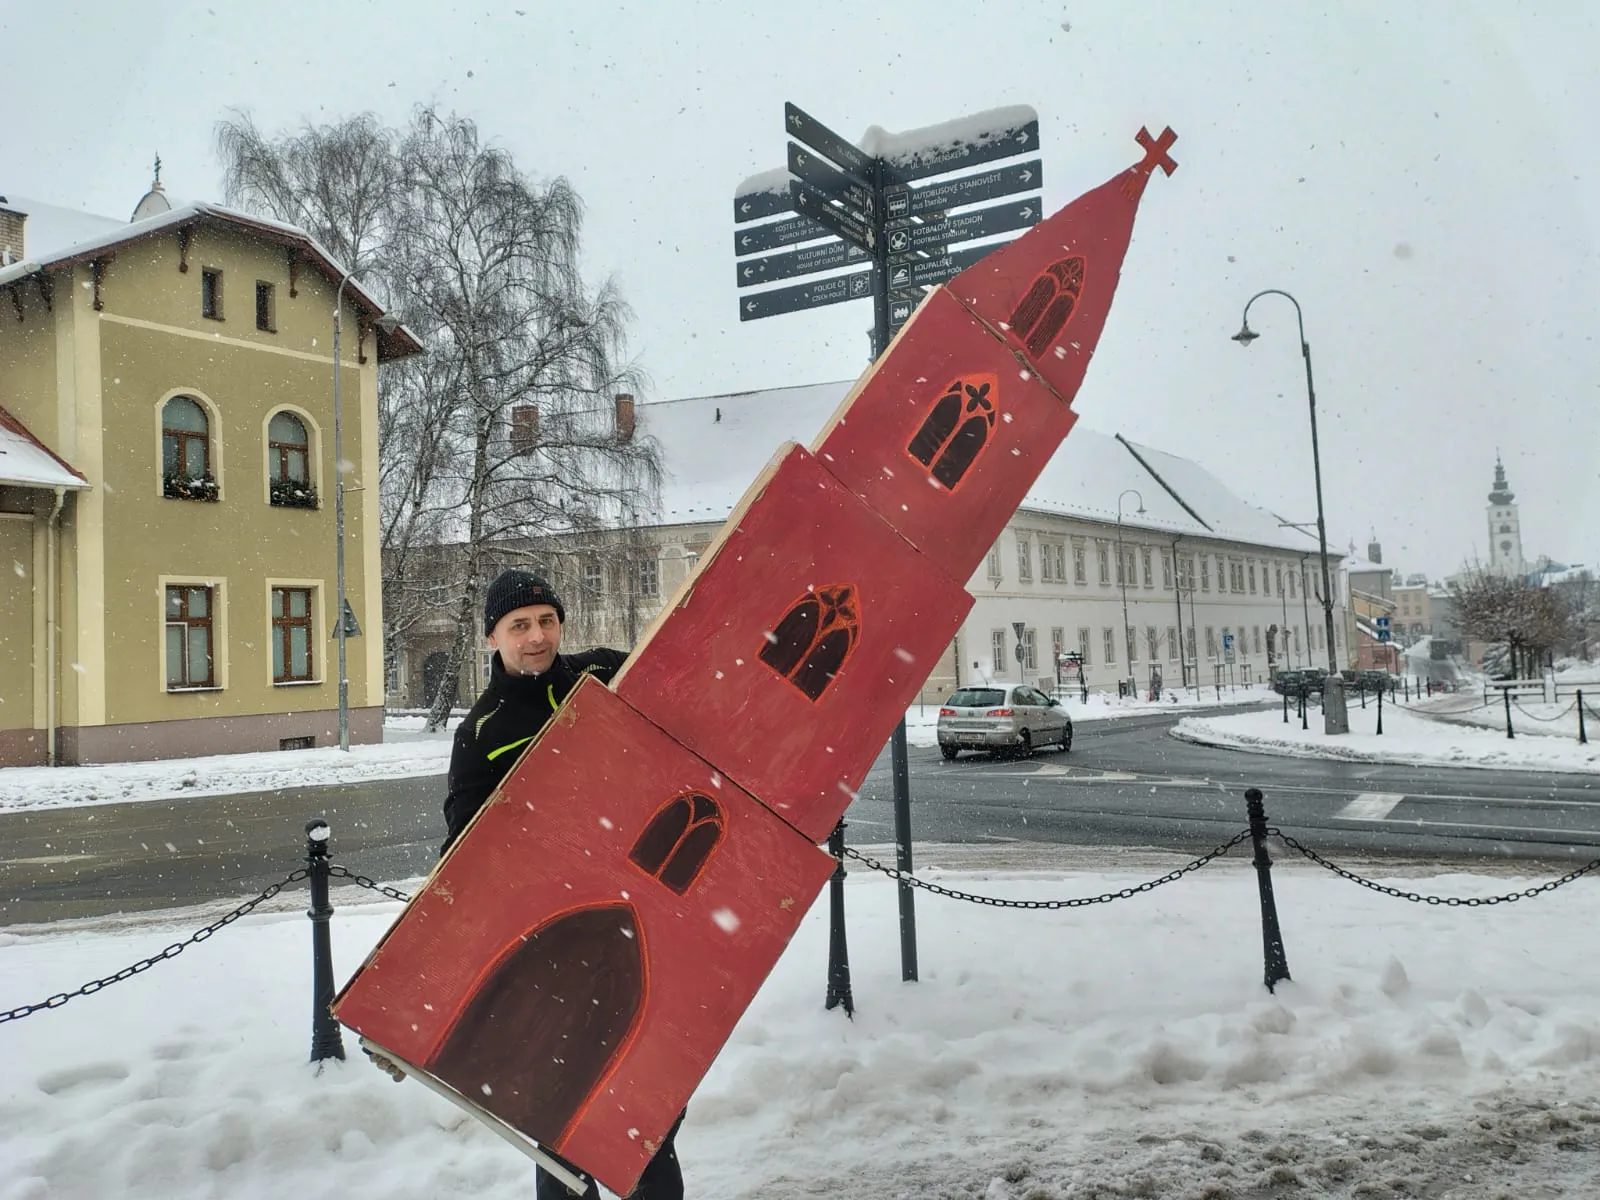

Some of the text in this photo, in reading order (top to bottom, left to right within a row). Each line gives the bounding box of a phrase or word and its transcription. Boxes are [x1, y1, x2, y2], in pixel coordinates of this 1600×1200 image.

[912, 185, 959, 200] AUTOBUSOVÉ
[913, 215, 983, 236] FOTBALOVÝ STADION
[913, 228, 968, 246] FOOTBALL STADIUM
[798, 248, 828, 260] KULTURNÍ
[813, 282, 836, 292] POLICIE
